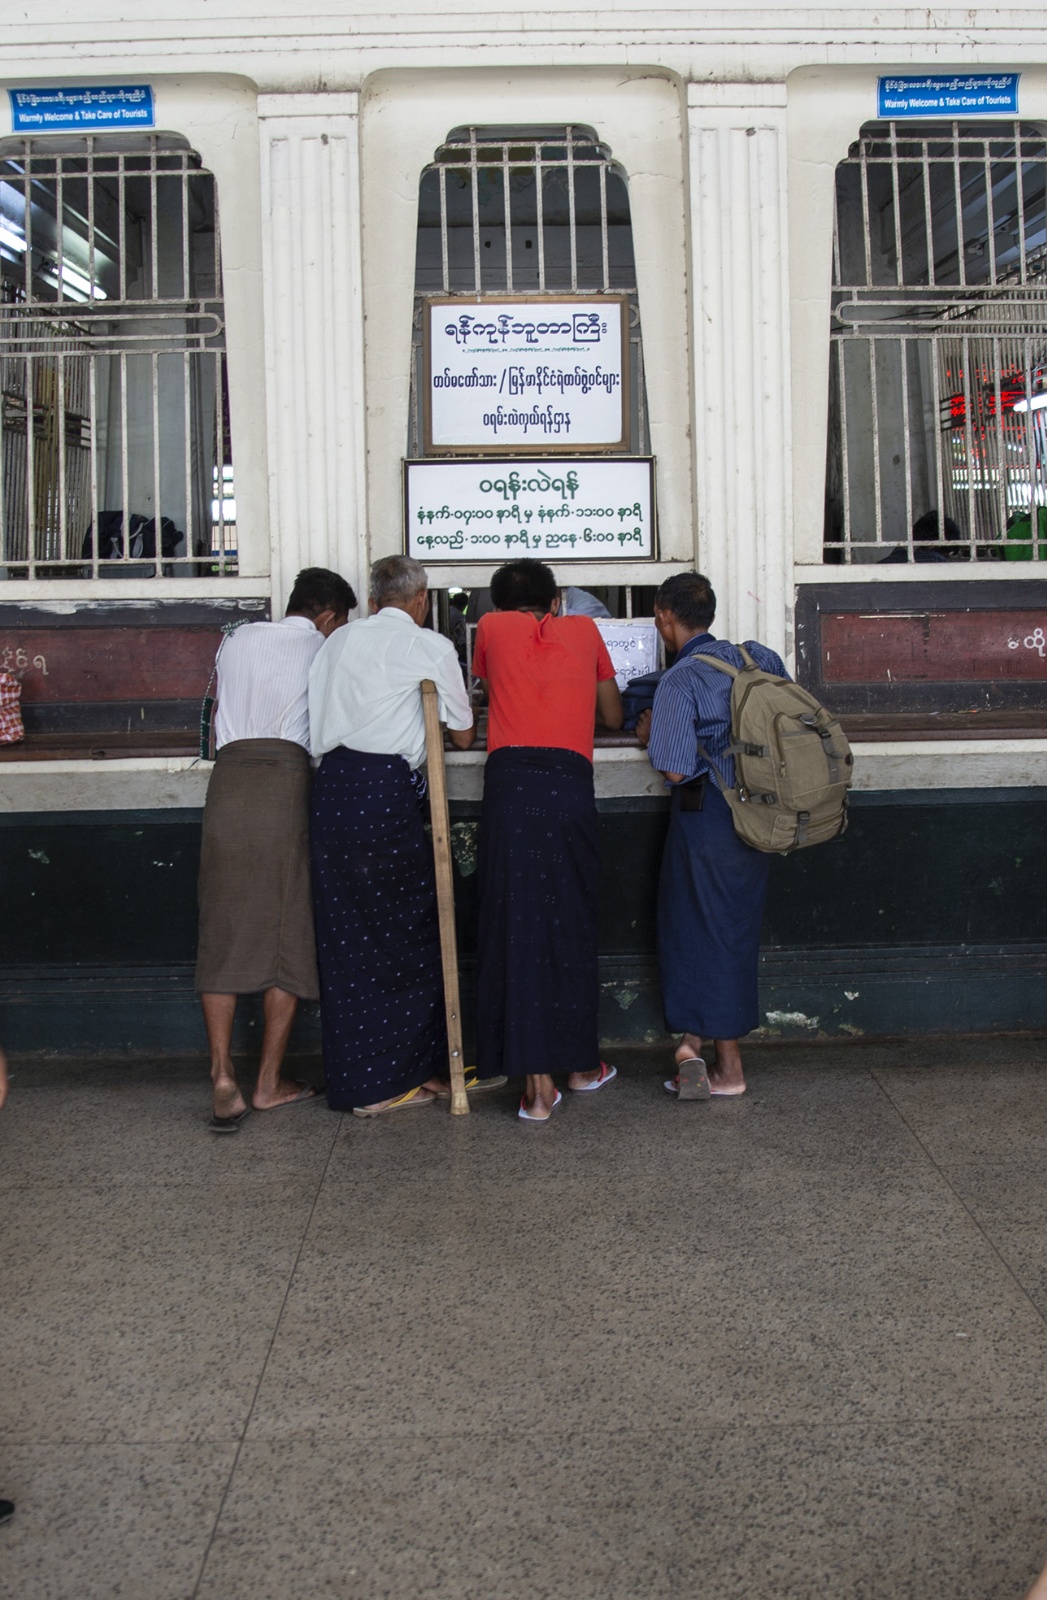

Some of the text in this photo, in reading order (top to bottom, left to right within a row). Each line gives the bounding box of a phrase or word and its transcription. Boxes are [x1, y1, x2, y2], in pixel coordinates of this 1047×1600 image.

[884, 95, 1012, 110] Warmly Welcome & Take Care of Tourists
[19, 109, 148, 124] Warmly Welcome & Take Care of Tourists
[444, 313, 608, 344] ရန်ကုန်ဘူတာကြီး
[523, 509, 533, 523] မှ
[532, 534, 542, 549] မှ
